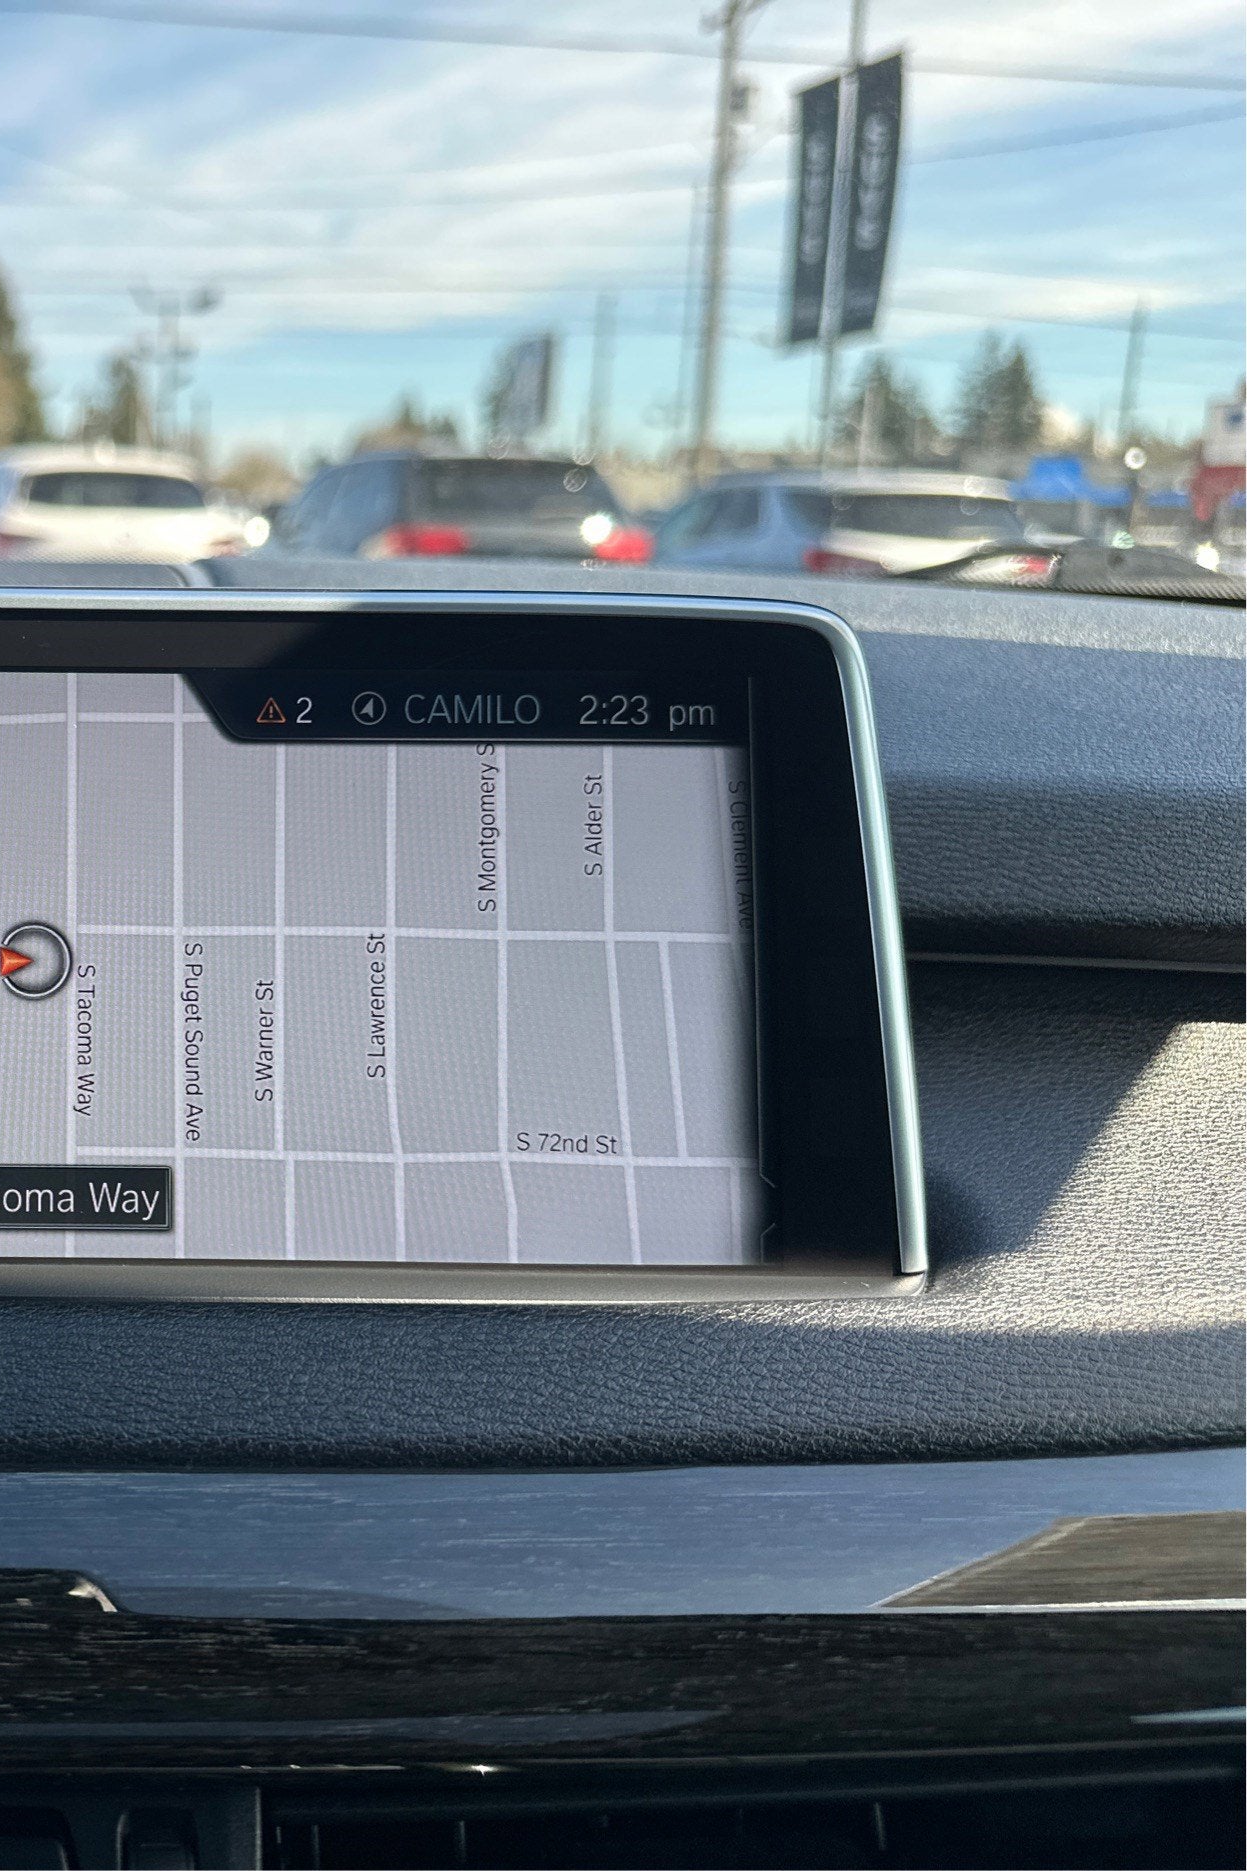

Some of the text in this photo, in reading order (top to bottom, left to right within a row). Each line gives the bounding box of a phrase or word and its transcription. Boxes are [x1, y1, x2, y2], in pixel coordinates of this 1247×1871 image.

[296, 696, 313, 724] 2
[404, 693, 540, 725] CAMILO
[579, 694, 715, 732] 2:23 pm
[475, 743, 500, 912] S Montgomery S
[583, 774, 603, 876] S Alder St
[727, 780, 746, 794] S
[730, 800, 752, 885] Clement
[72, 964, 96, 1117] S Tacoma Way
[180, 942, 204, 1142] S Puget Sound Ave
[254, 979, 274, 1102] S Warner St
[366, 933, 386, 1078] S Lawrence St
[516, 1132, 618, 1155] S 72nd St
[88, 1182, 160, 1221] Way
